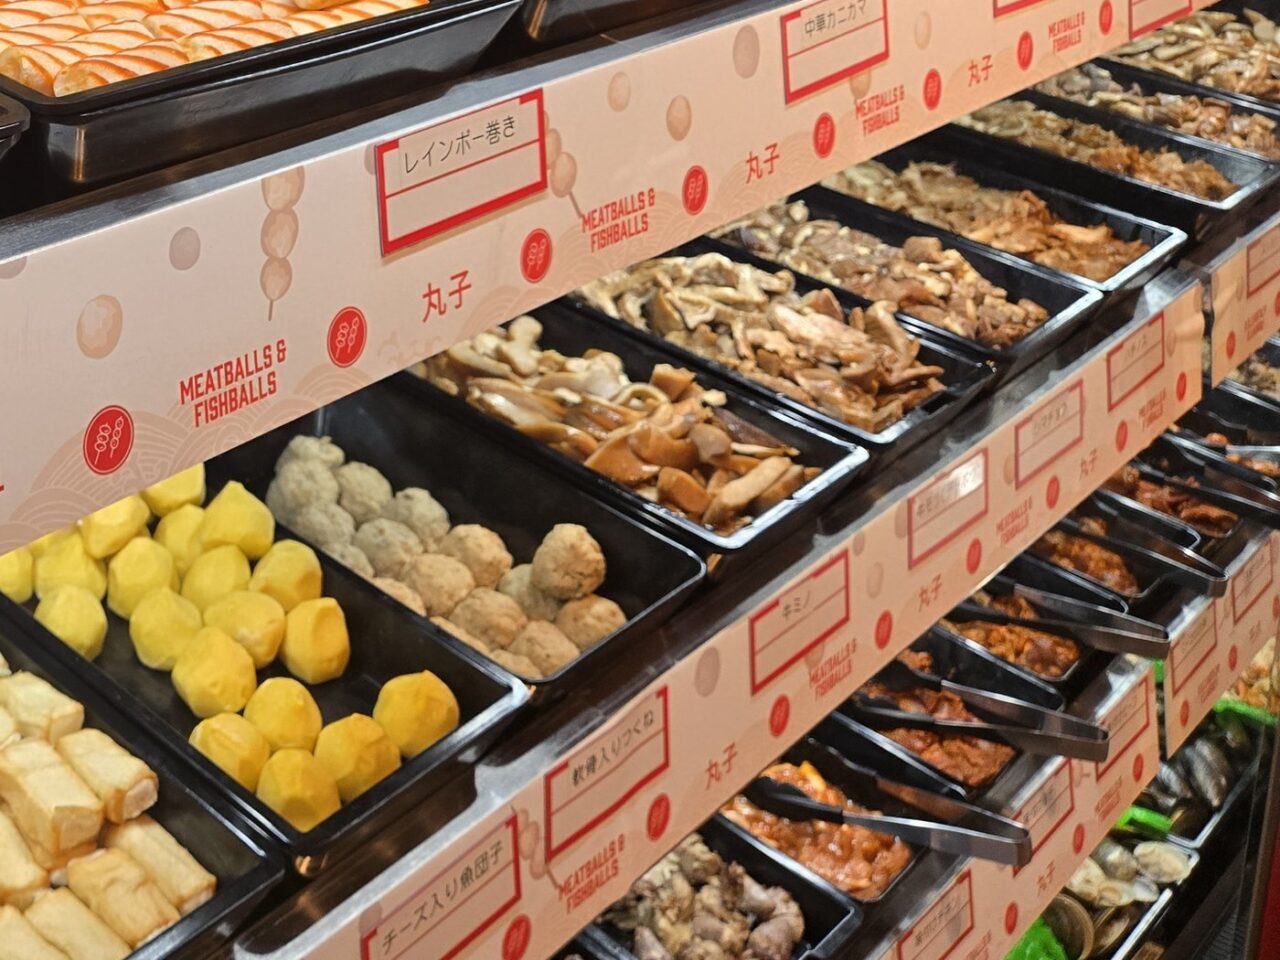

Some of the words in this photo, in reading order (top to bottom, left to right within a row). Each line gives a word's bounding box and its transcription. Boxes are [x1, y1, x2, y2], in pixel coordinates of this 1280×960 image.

[968, 54, 993, 87] 丸子
[855, 87, 899, 120] MEATBALLS
[403, 114, 517, 175] レインボー巻き
[745, 142, 780, 184] 丸子
[580, 191, 646, 234] MEATBALLS
[647, 187, 656, 207] &
[589, 213, 650, 253] FISHBALLS
[421, 270, 472, 323] 丸子
[179, 343, 272, 406] MEATBALLS
[275, 339, 287, 363] &
[193, 371, 278, 428] FISHBALLS
[705, 742, 738, 790] 丸子
[558, 841, 616, 900] MEATBALLS
[566, 859, 619, 914] FISHBALLS
[382, 841, 503, 956] チーズ入り魚団子
